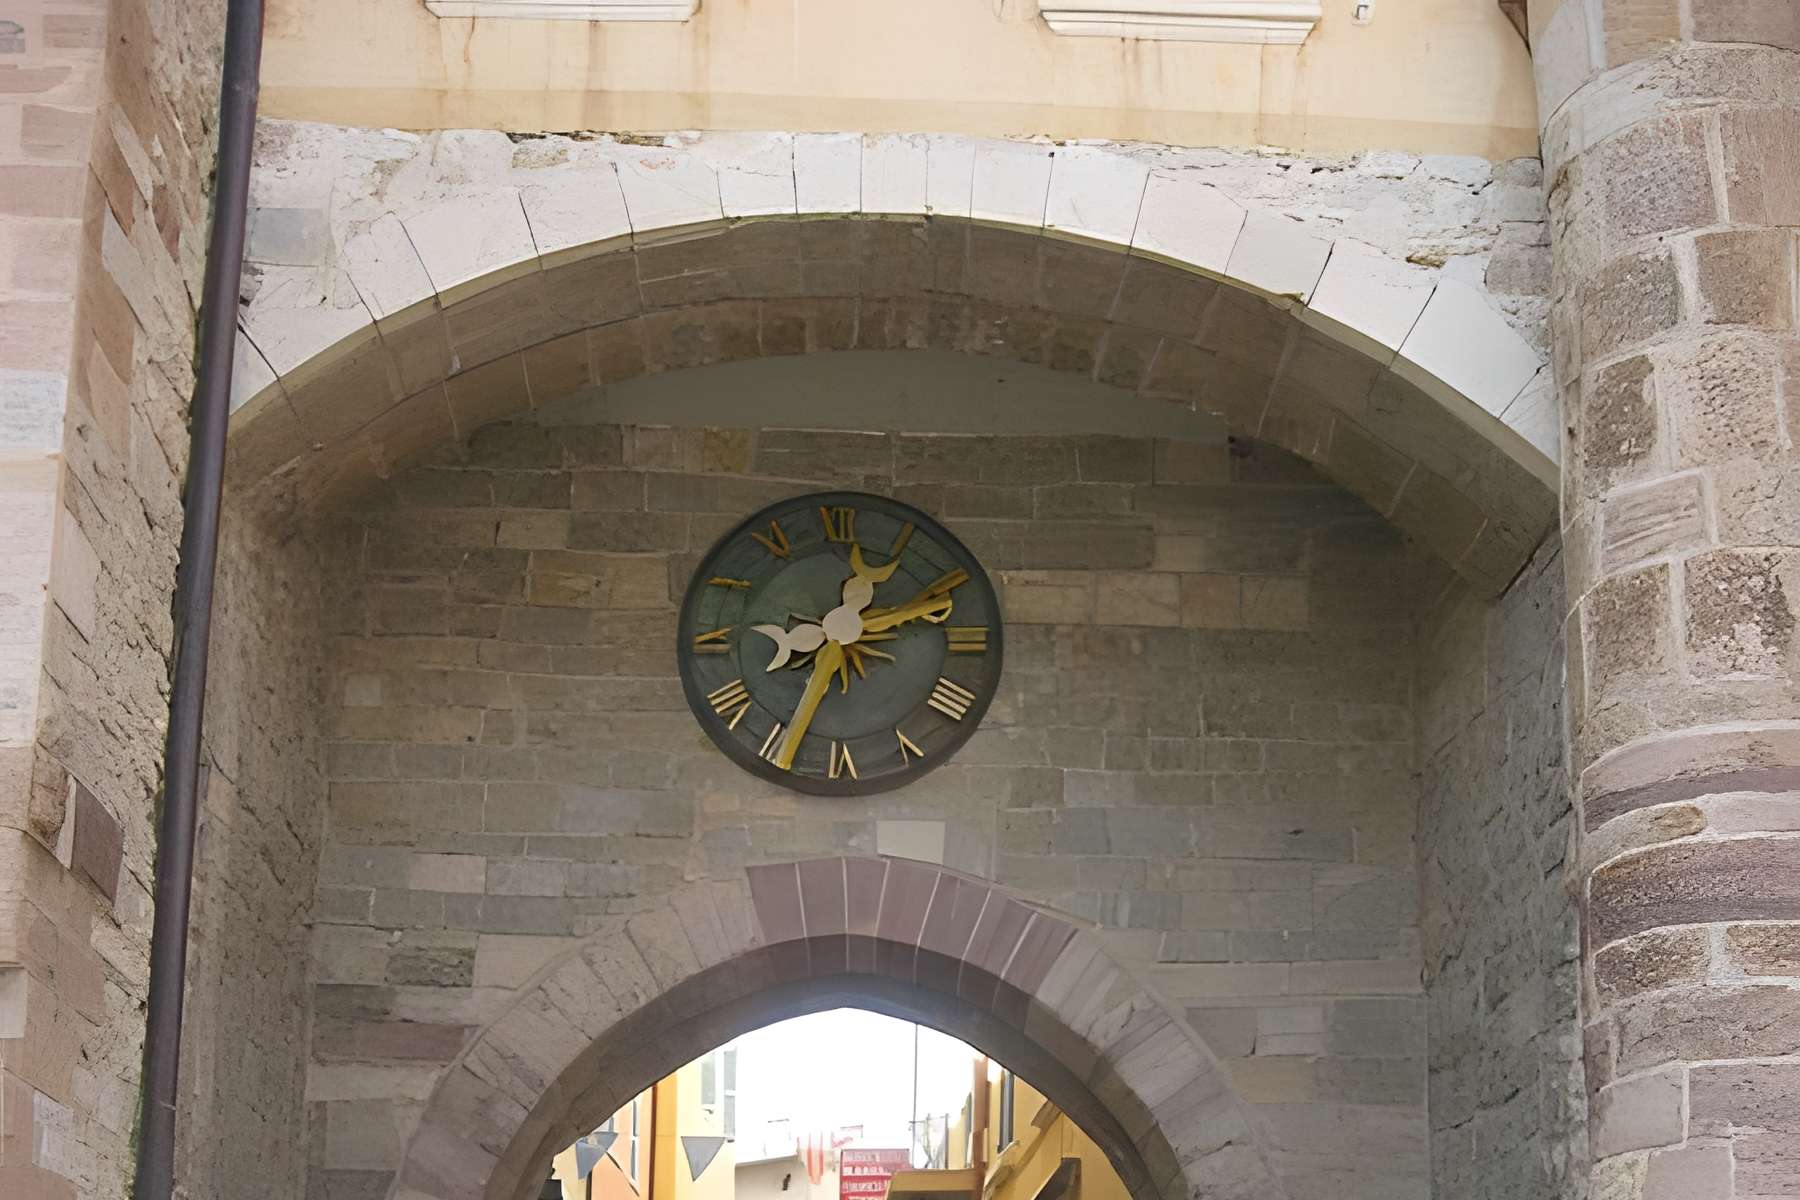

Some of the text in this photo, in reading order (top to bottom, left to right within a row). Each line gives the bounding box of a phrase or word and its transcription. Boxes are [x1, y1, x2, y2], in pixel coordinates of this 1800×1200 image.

[707, 678, 753, 730] VIII
[927, 676, 977, 721] IIII
[828, 740, 858, 781] VI
